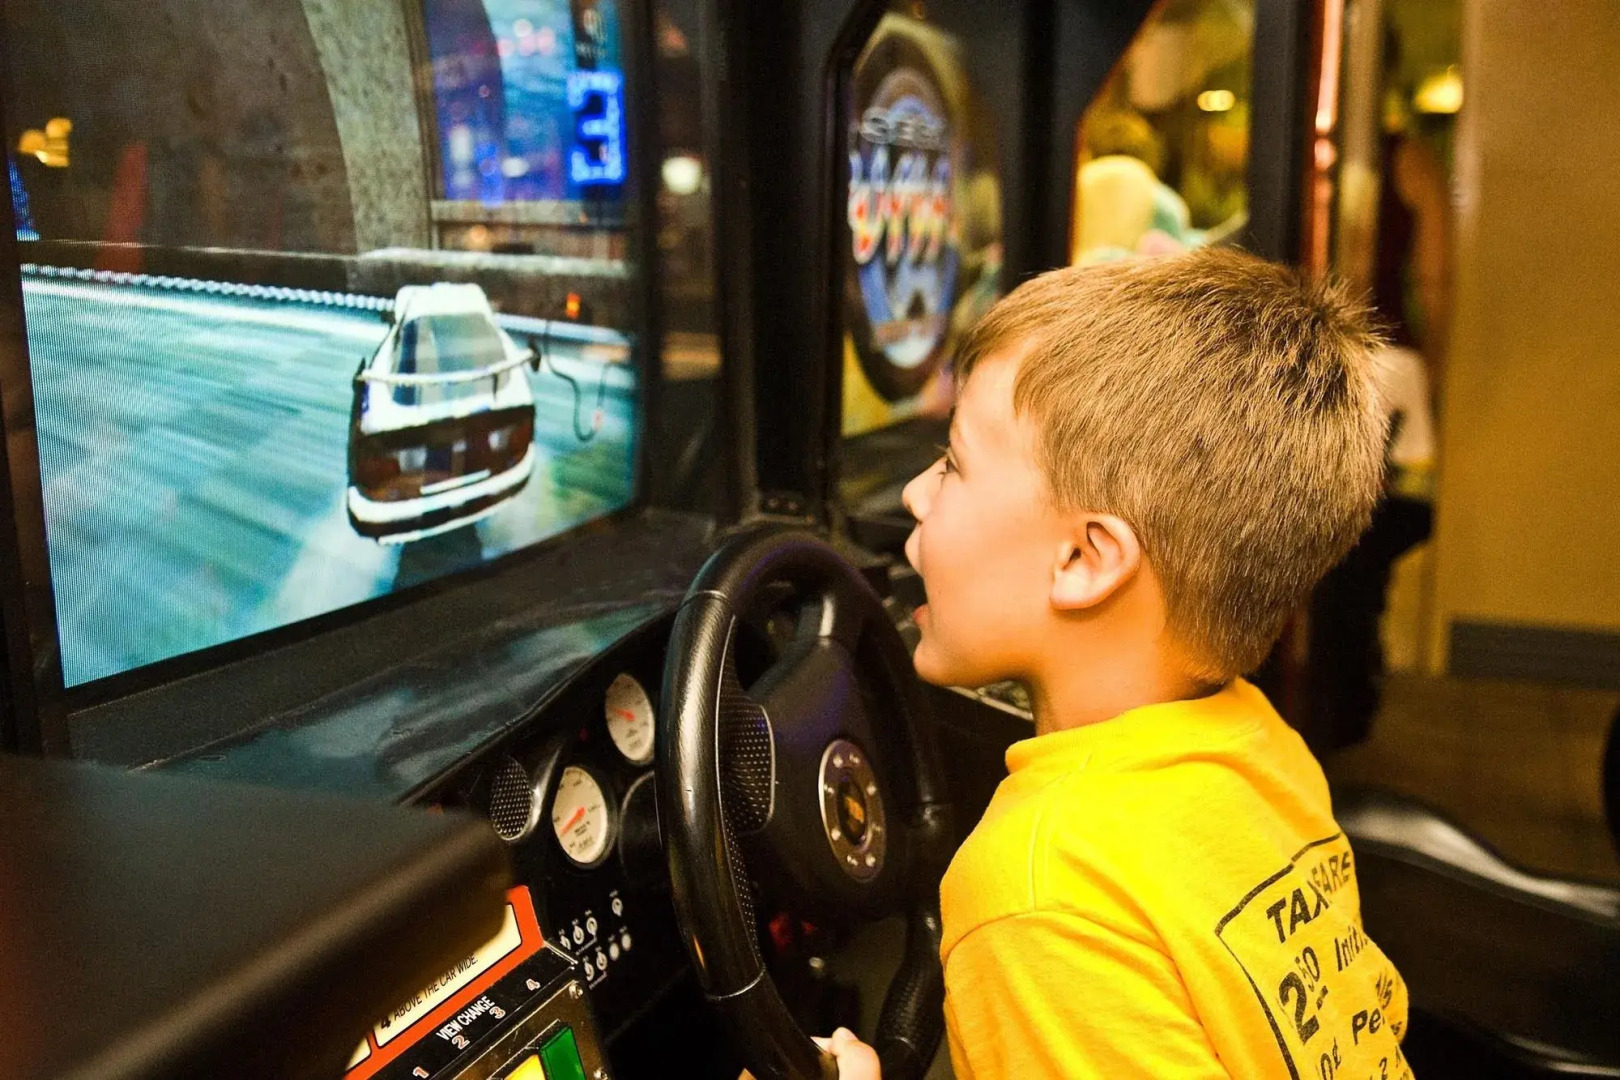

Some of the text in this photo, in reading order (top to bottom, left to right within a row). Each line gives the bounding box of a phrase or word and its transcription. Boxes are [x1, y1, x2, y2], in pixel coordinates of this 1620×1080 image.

[1266, 880, 1330, 944] TAX
[393, 994, 422, 1021] ABOVE
[424, 982, 440, 999] THE
[440, 966, 457, 987] CAR
[436, 995, 496, 1041] VIEW CHANGE
[412, 978, 541, 1079] 1 2 3 4
